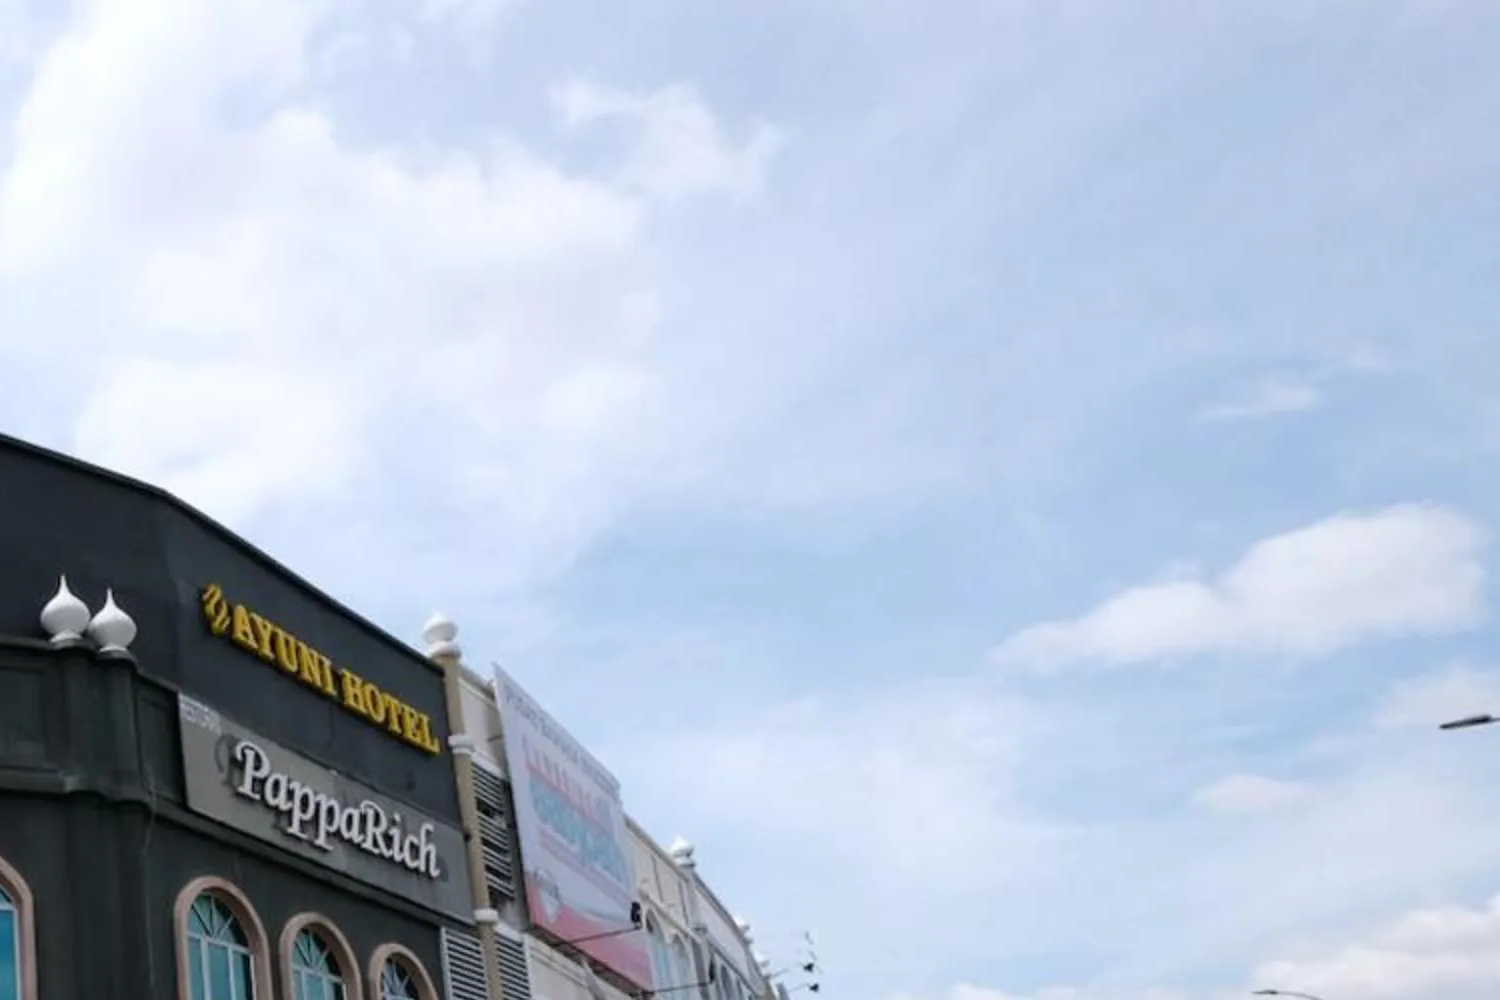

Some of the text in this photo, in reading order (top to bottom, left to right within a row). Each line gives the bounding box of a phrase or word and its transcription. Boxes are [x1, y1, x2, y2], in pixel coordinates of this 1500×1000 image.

[231, 604, 337, 697] AYUNI
[339, 668, 441, 754] HOTEL
[236, 740, 441, 878] PappaRich
